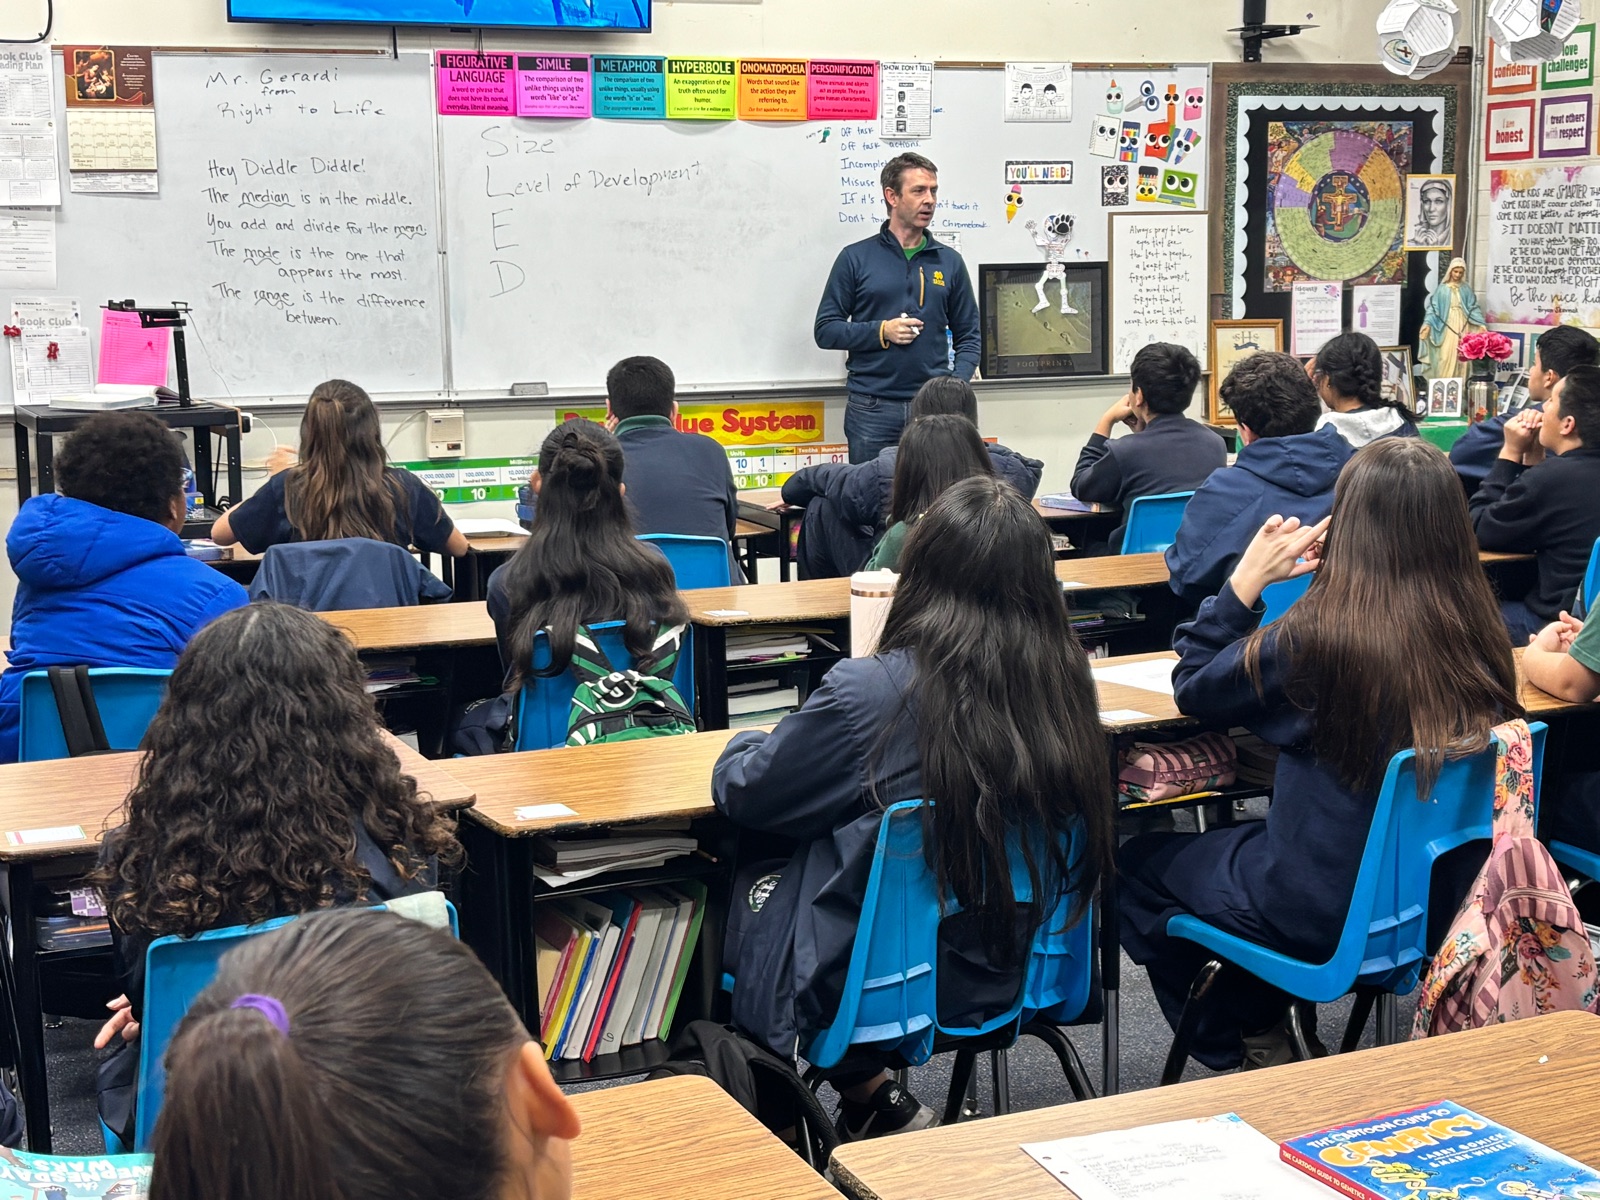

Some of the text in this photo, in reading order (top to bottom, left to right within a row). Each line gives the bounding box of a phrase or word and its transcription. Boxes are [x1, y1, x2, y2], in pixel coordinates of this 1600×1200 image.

[19, 52, 43, 60] Club
[1562, 44, 1579, 57] love
[446, 55, 508, 69] FIGURATIVE
[536, 58, 571, 70] SIMILE
[600, 60, 657, 72] METAPHOR
[672, 61, 731, 74] HYPERBOLE
[742, 63, 806, 74] ONOMATOPOEIA
[811, 64, 873, 75] PERSONIFICATION
[1547, 58, 1588, 73] challenges
[205, 67, 340, 88] Mr. Gerardi
[449, 70, 506, 83] LANGUAGE
[1494, 64, 1531, 79] confident
[261, 86, 296, 96] from
[777, 88, 788, 96] they
[758, 96, 780, 104] referring
[217, 100, 386, 125] Right to Life
[1550, 115, 1565, 125] treat
[1565, 112, 1585, 123] others
[1495, 128, 1524, 144] honest
[1559, 126, 1585, 140] respect
[481, 125, 556, 158] Size
[208, 156, 367, 185] Hey Diddle Diddle!
[1009, 166, 1070, 179] YOU'LL NEED:
[486, 160, 703, 198] Level of Development
[841, 176, 875, 188] Misuse
[201, 187, 413, 206] The median is in the middle.
[1527, 187, 1541, 197] KIDS
[1556, 184, 1588, 199] SMARTER
[1501, 200, 1516, 209] SOME
[1518, 200, 1530, 209] KIDS
[1496, 211, 1512, 220] SOME
[1513, 211, 1527, 220] KIDS
[207, 212, 232, 235] You
[241, 218, 268, 230] add
[275, 219, 295, 231] and
[303, 219, 340, 233] divide
[346, 221, 363, 235] for
[366, 222, 389, 234] the
[492, 208, 520, 251] E
[1509, 224, 1524, 235] IT
[207, 239, 406, 262] The mode is the one that
[278, 264, 408, 284] appears the most.
[489, 260, 526, 298] D
[211, 281, 426, 310] The range is the difference
[1510, 285, 1525, 307] Be
[1526, 286, 1547, 303] the
[19, 317, 72, 326] Book Club
[286, 310, 342, 326] between.
[722, 408, 816, 437] System
[735, 458, 748, 469] 10
[1306, 1108, 1451, 1149] THE CARTOON GUIDE TO
[1319, 1113, 1488, 1168] GENETICS
[1417, 1132, 1508, 1161] LARRY GONICK
[33, 1159, 115, 1173] WARS
[1282, 1149, 1366, 1200] THE CARTOON GUIDE TO GENETICS
